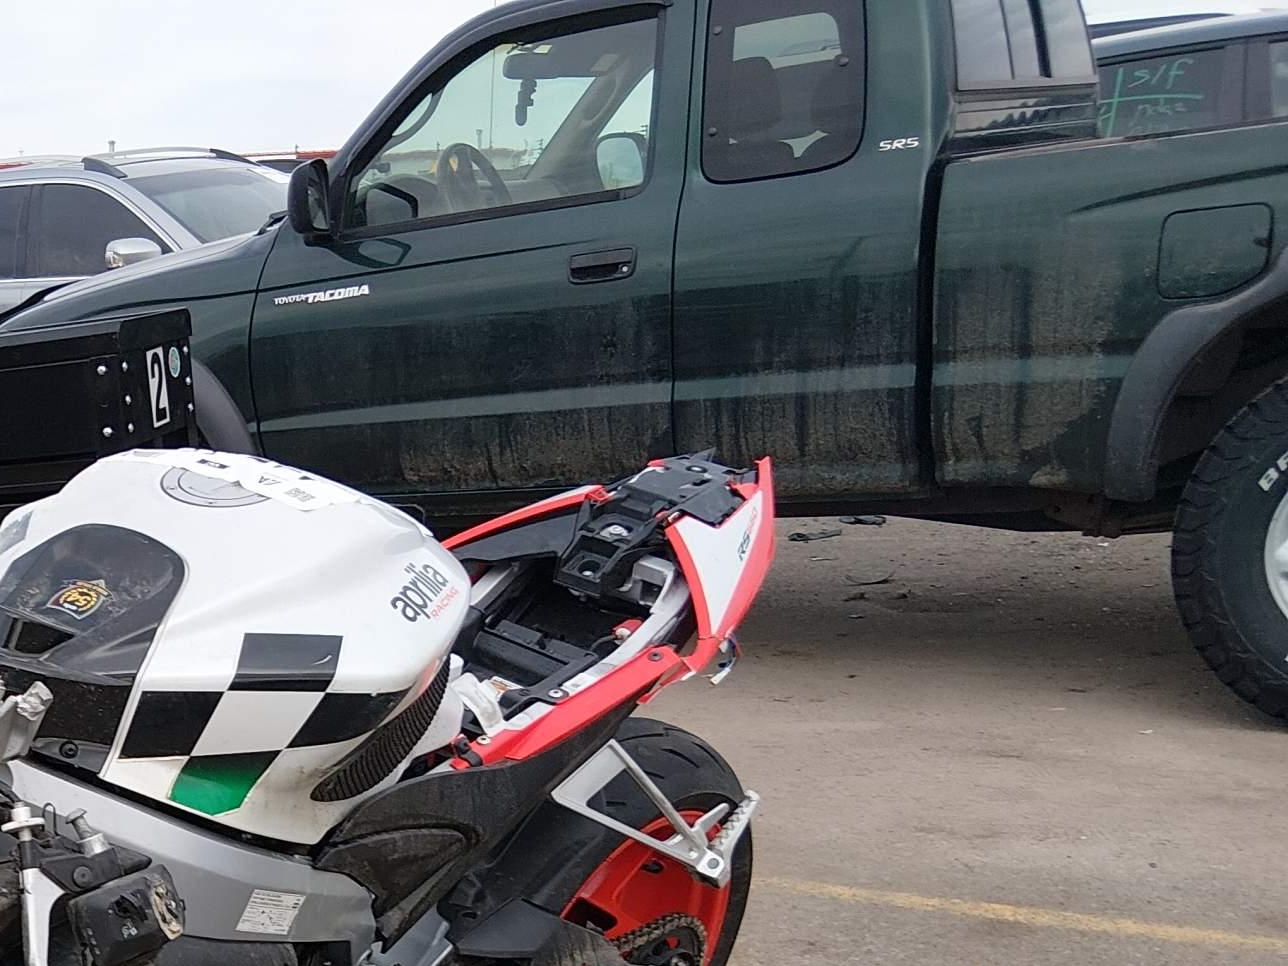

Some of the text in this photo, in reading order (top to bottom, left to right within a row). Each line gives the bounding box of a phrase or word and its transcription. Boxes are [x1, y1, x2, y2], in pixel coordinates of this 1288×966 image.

[879, 136, 920, 151] SR5
[273, 284, 370, 305] TOYOTA TACOMA
[150, 352, 168, 423] 2
[390, 562, 449, 622] aprilia
